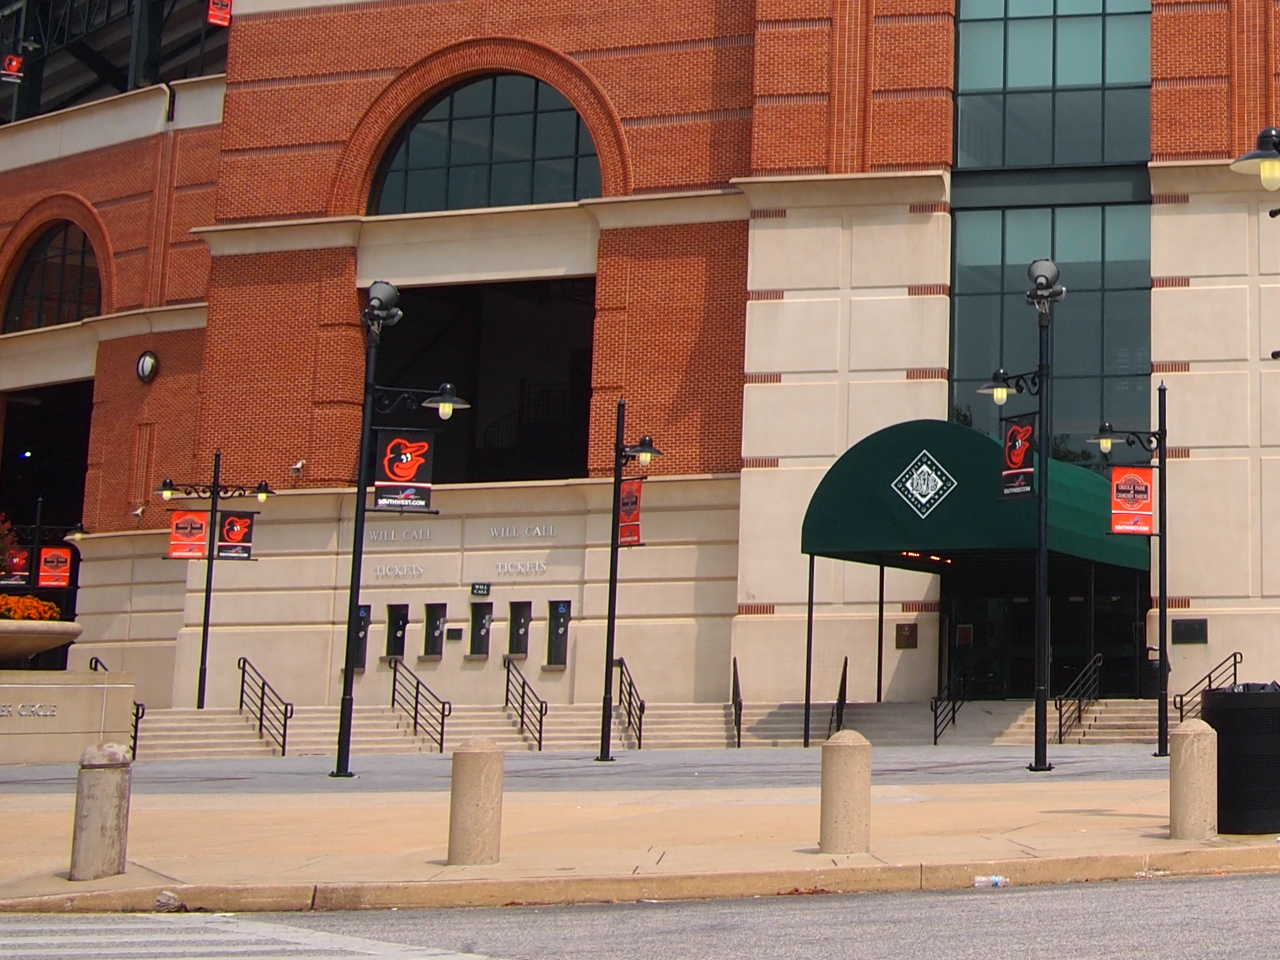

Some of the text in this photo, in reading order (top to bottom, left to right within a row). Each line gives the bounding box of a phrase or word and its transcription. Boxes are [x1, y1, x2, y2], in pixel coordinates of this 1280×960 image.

[378, 498, 426, 506] SOUTHWEST.COM
[369, 529, 433, 541] WILL CALL
[490, 526, 557, 538] WILL CALL
[376, 564, 424, 576] TICKETS
[496, 561, 547, 573] TICKETS
